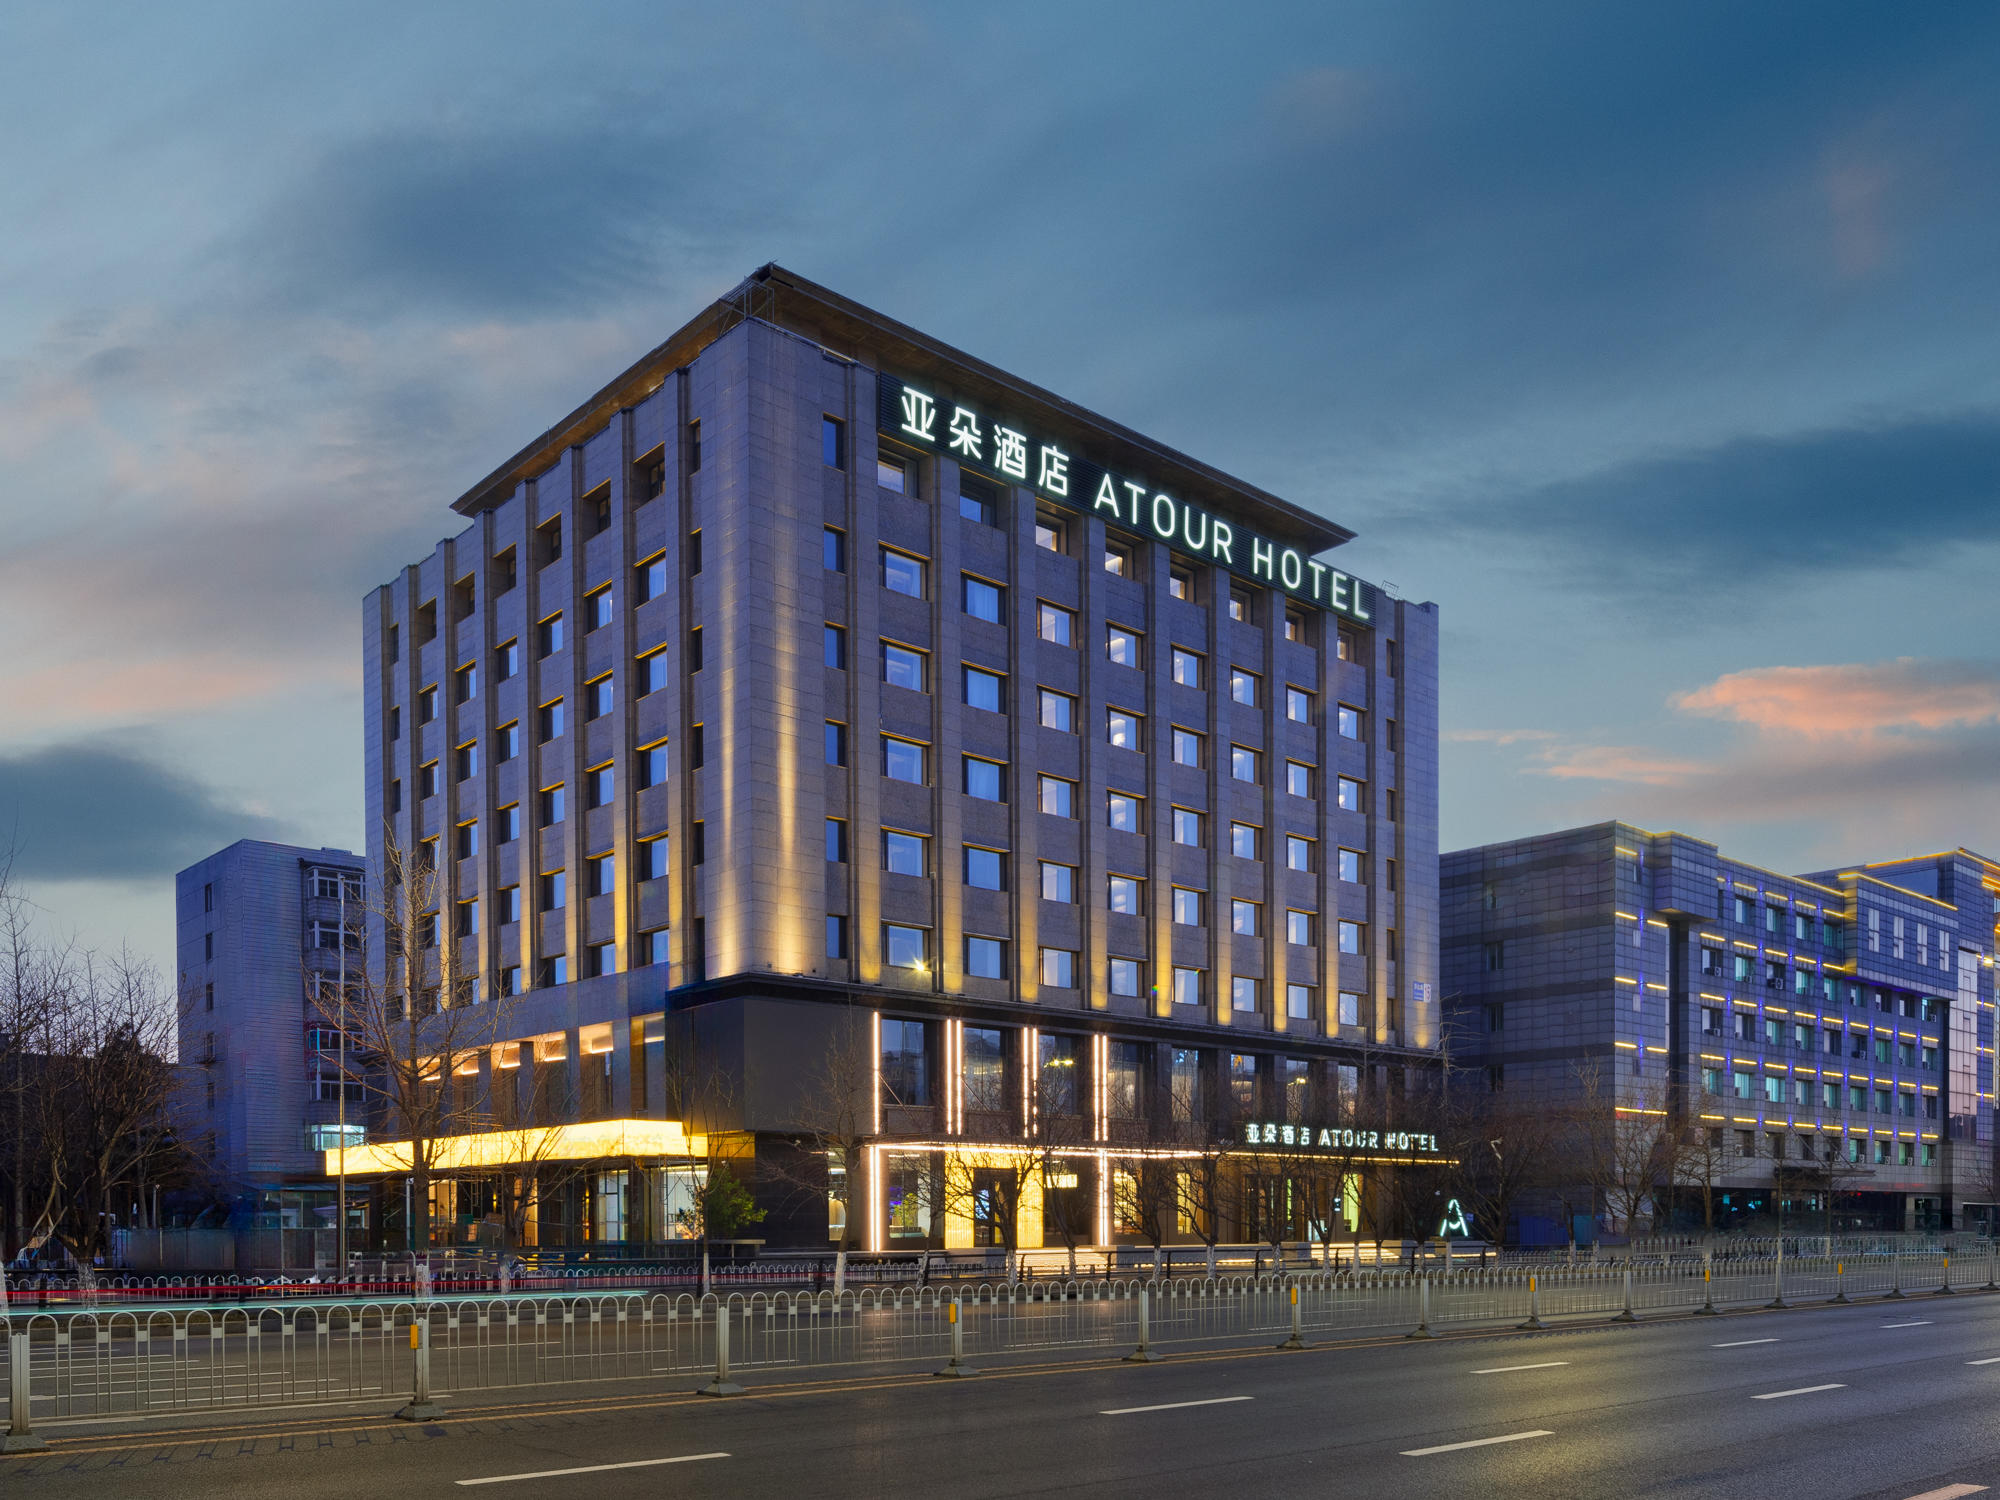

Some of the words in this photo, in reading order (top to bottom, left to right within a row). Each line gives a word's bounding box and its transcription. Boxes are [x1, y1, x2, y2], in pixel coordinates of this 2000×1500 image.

[901, 386, 1070, 496] 亚朵酒店
[1094, 473, 1233, 564] ATOUR
[1253, 537, 1370, 620] HOTEL
[1318, 1128, 1378, 1149] ATOUR
[1384, 1132, 1440, 1152] HOTEL
